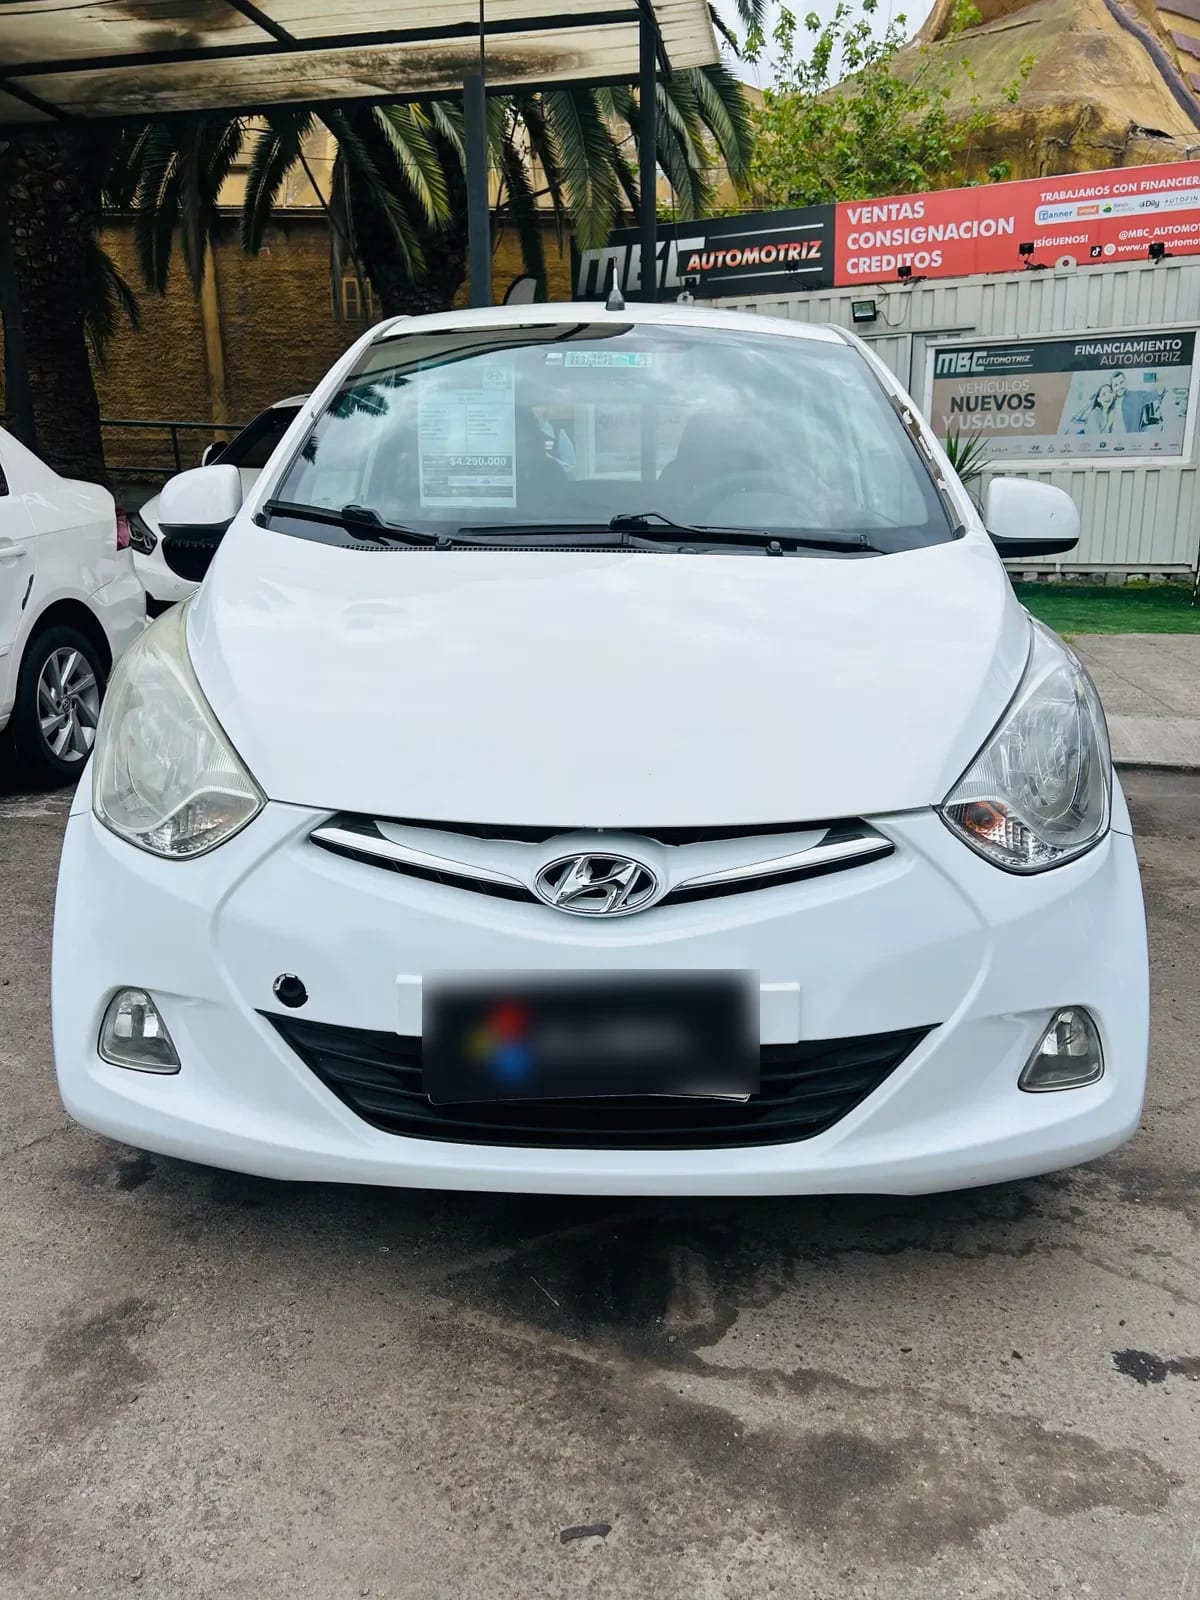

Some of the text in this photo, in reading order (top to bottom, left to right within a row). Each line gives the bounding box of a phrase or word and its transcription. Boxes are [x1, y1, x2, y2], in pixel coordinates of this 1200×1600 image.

[1040, 175, 1200, 202] TRABAJAMOS CON FINANCIER
[847, 201, 925, 225] VENTAS
[1038, 210, 1073, 221] Tanner
[847, 216, 1015, 250] CONSIGNACION
[686, 240, 823, 271] AUTOMOTRIZ
[846, 250, 943, 274] CREDITOS
[1074, 339, 1182, 356] FINANCIAMIENTO
[935, 351, 1032, 374] MBC AUTOMOTRIZ
[1100, 352, 1181, 366] AUTOMOTRIZ
[958, 379, 1031, 395] VEHÍCULOS
[950, 392, 1036, 413] NUEVOS
[942, 412, 1036, 431] Y USADOS
[449, 456, 507, 466] $4.290.000
